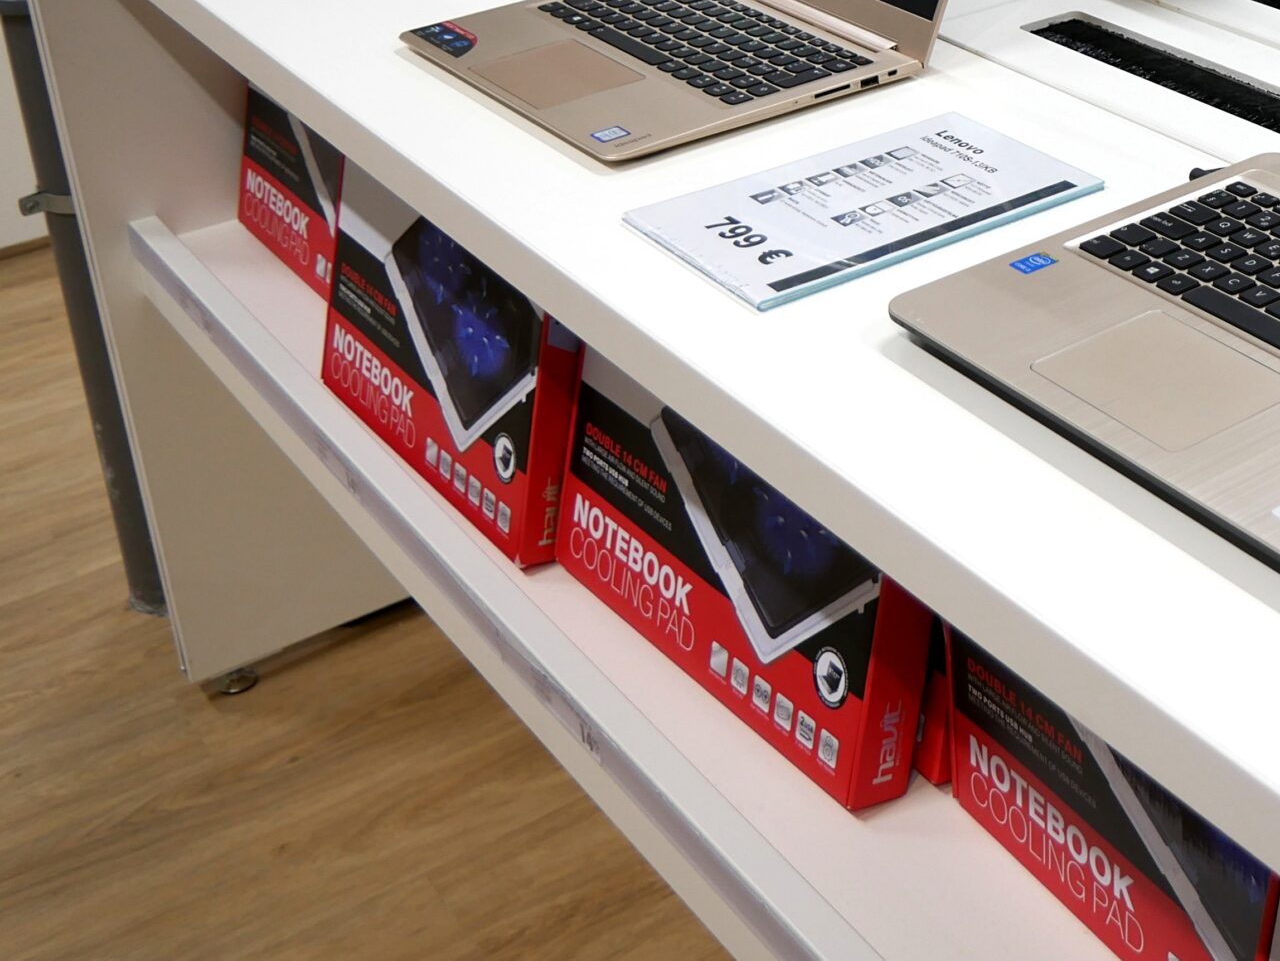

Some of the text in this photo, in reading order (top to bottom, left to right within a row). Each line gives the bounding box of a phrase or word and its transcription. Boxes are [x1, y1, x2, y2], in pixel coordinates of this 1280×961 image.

[935, 129, 984, 155] Lenovo
[247, 168, 310, 240] NOTEBOOK
[704, 215, 794, 265] 799 €
[331, 352, 415, 448] COOLING PAD
[333, 323, 414, 418] NOTEBOOK
[586, 422, 667, 493] DOUBLE 14 CM FAN
[570, 527, 695, 651] COOLING PAD
[574, 493, 693, 616] NOTEBOOK
[967, 657, 1017, 707] DOUBLE
[1036, 712, 1055, 739] CM
[1058, 733, 1083, 764] FAN
[968, 684, 1032, 743] TWO PORTS USB HUB
[969, 733, 1135, 913] NOTEBOOK
[970, 771, 1144, 953] COOLING PAD
